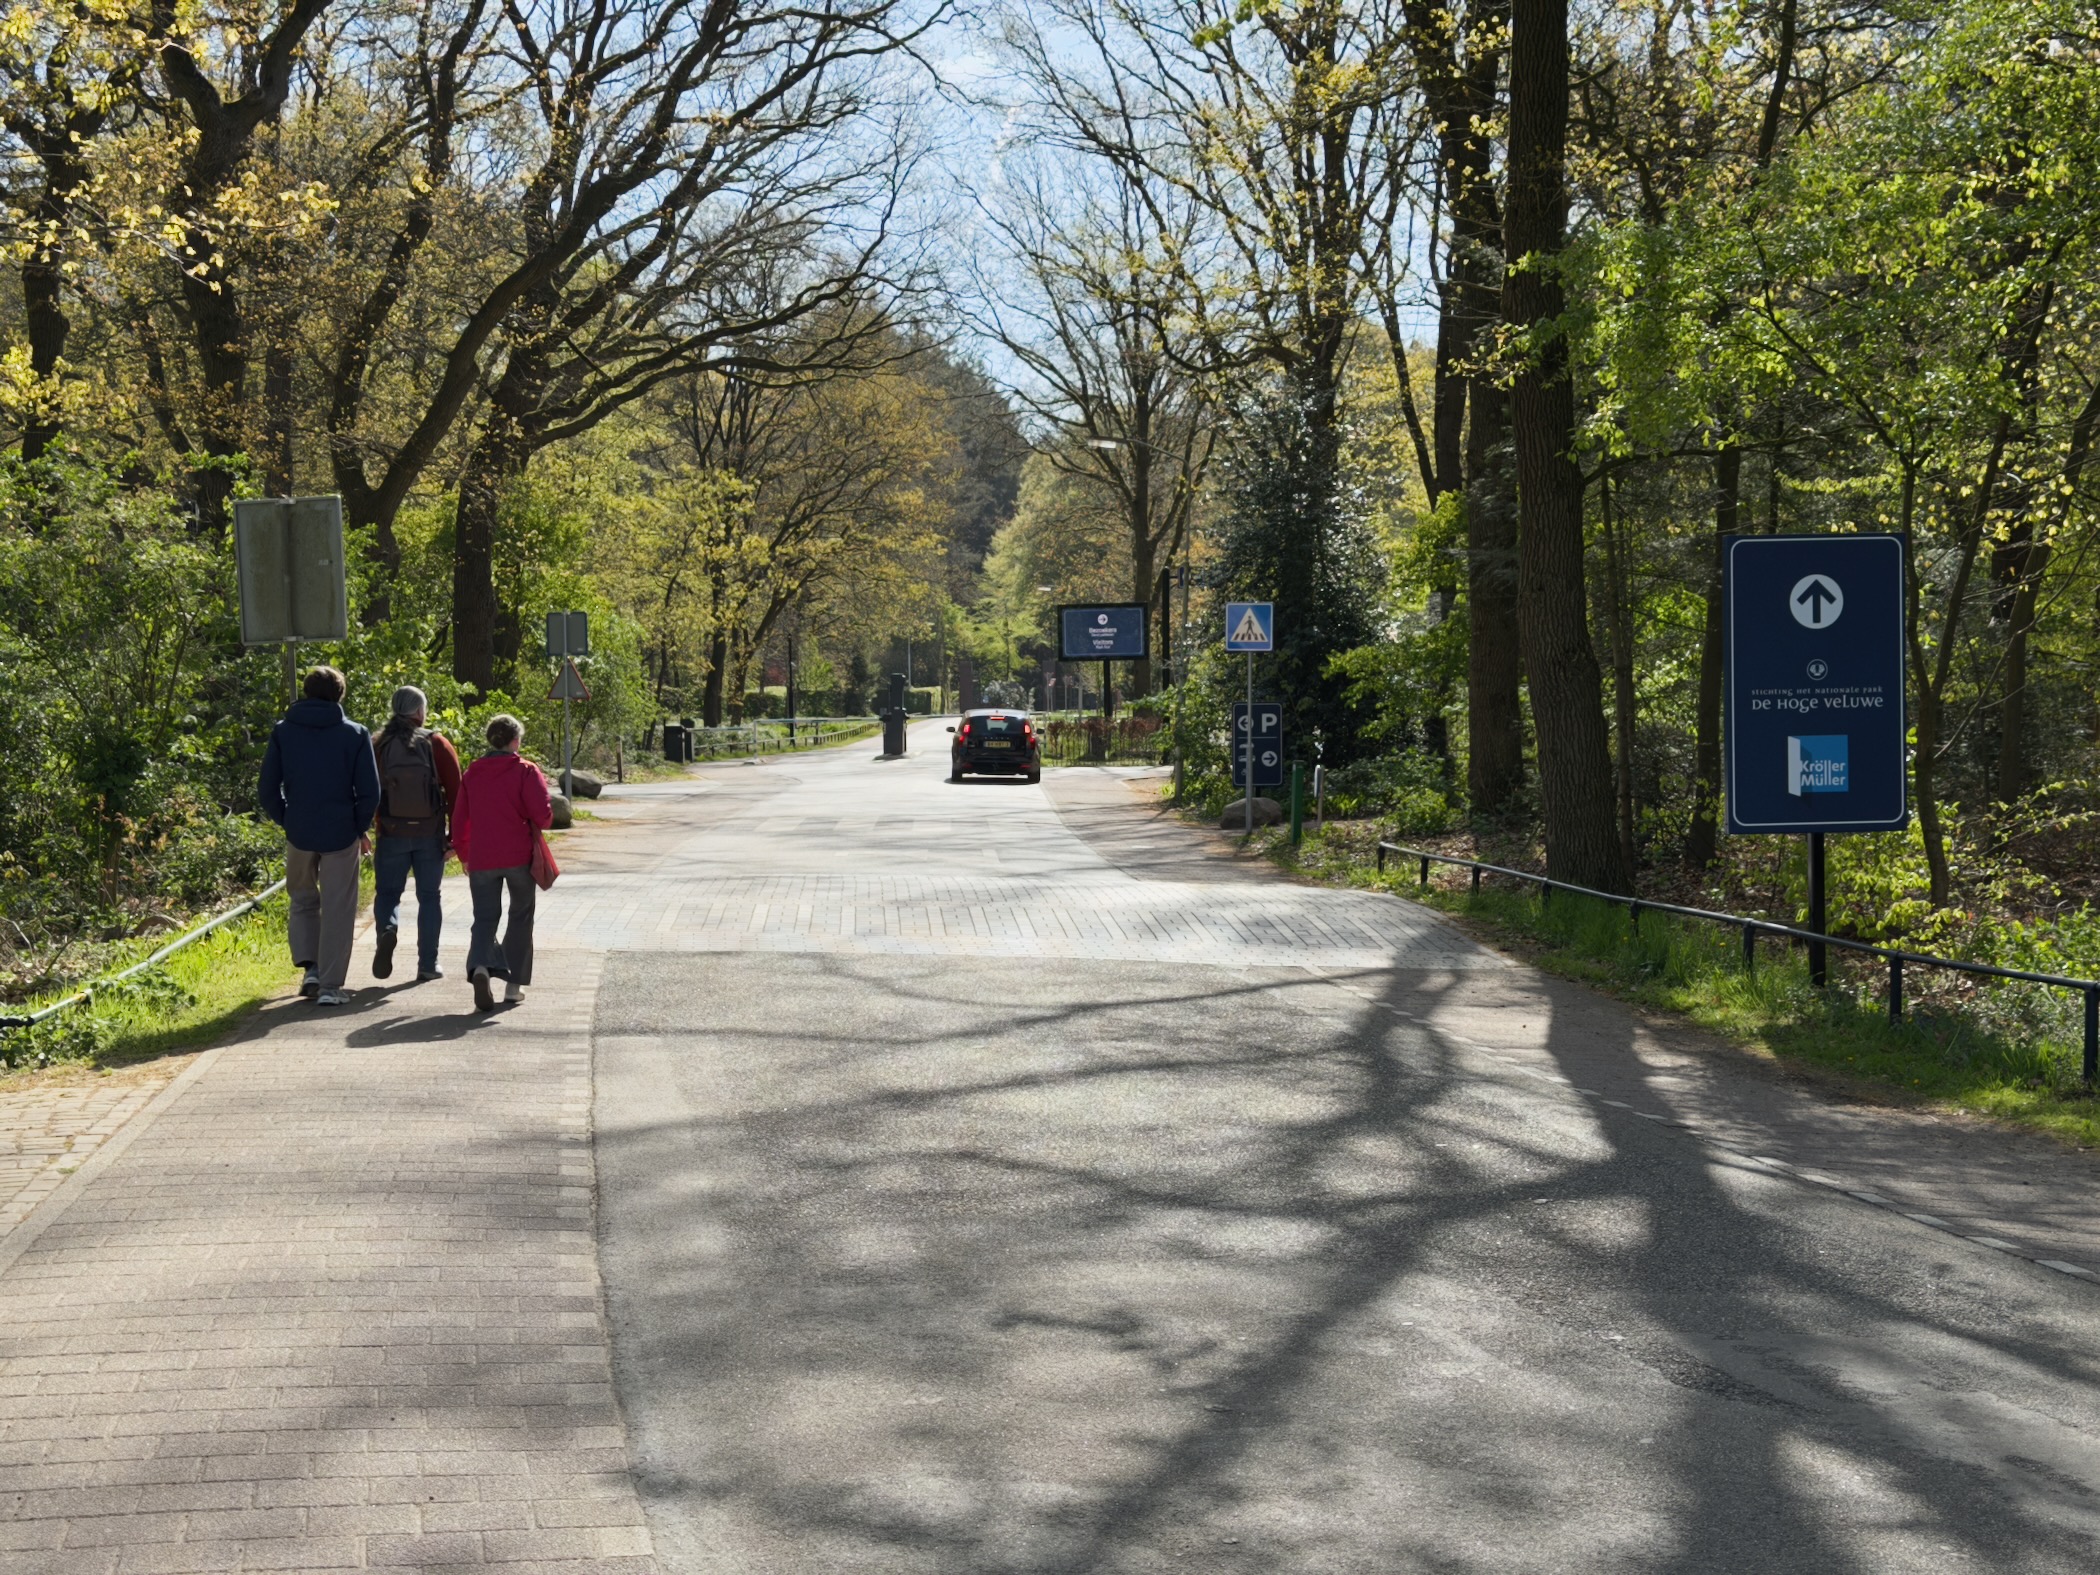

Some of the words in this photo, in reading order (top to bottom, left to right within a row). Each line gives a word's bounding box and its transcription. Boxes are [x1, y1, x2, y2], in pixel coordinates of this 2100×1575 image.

[1262, 713, 1278, 733] P
[1800, 760, 1846, 772] Kröller
[1801, 774, 1846, 786] Müller
